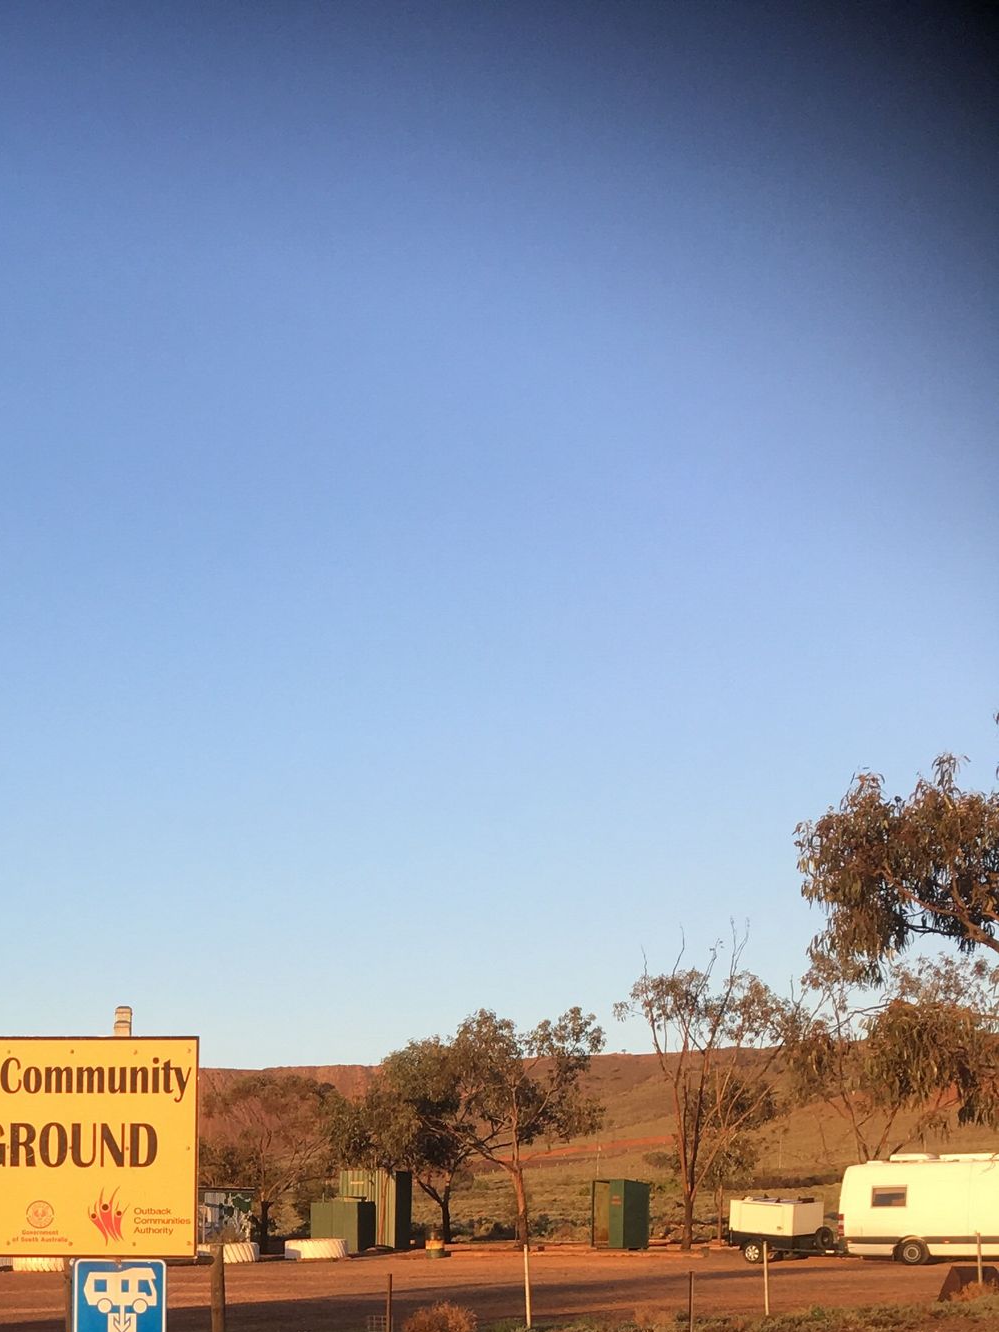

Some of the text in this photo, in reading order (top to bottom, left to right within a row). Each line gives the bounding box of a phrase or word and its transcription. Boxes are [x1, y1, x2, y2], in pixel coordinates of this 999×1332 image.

[0, 1056, 192, 1103] Community
[133, 1207, 172, 1215] Outback
[133, 1217, 191, 1225] Communities
[133, 1226, 174, 1235] Authority
